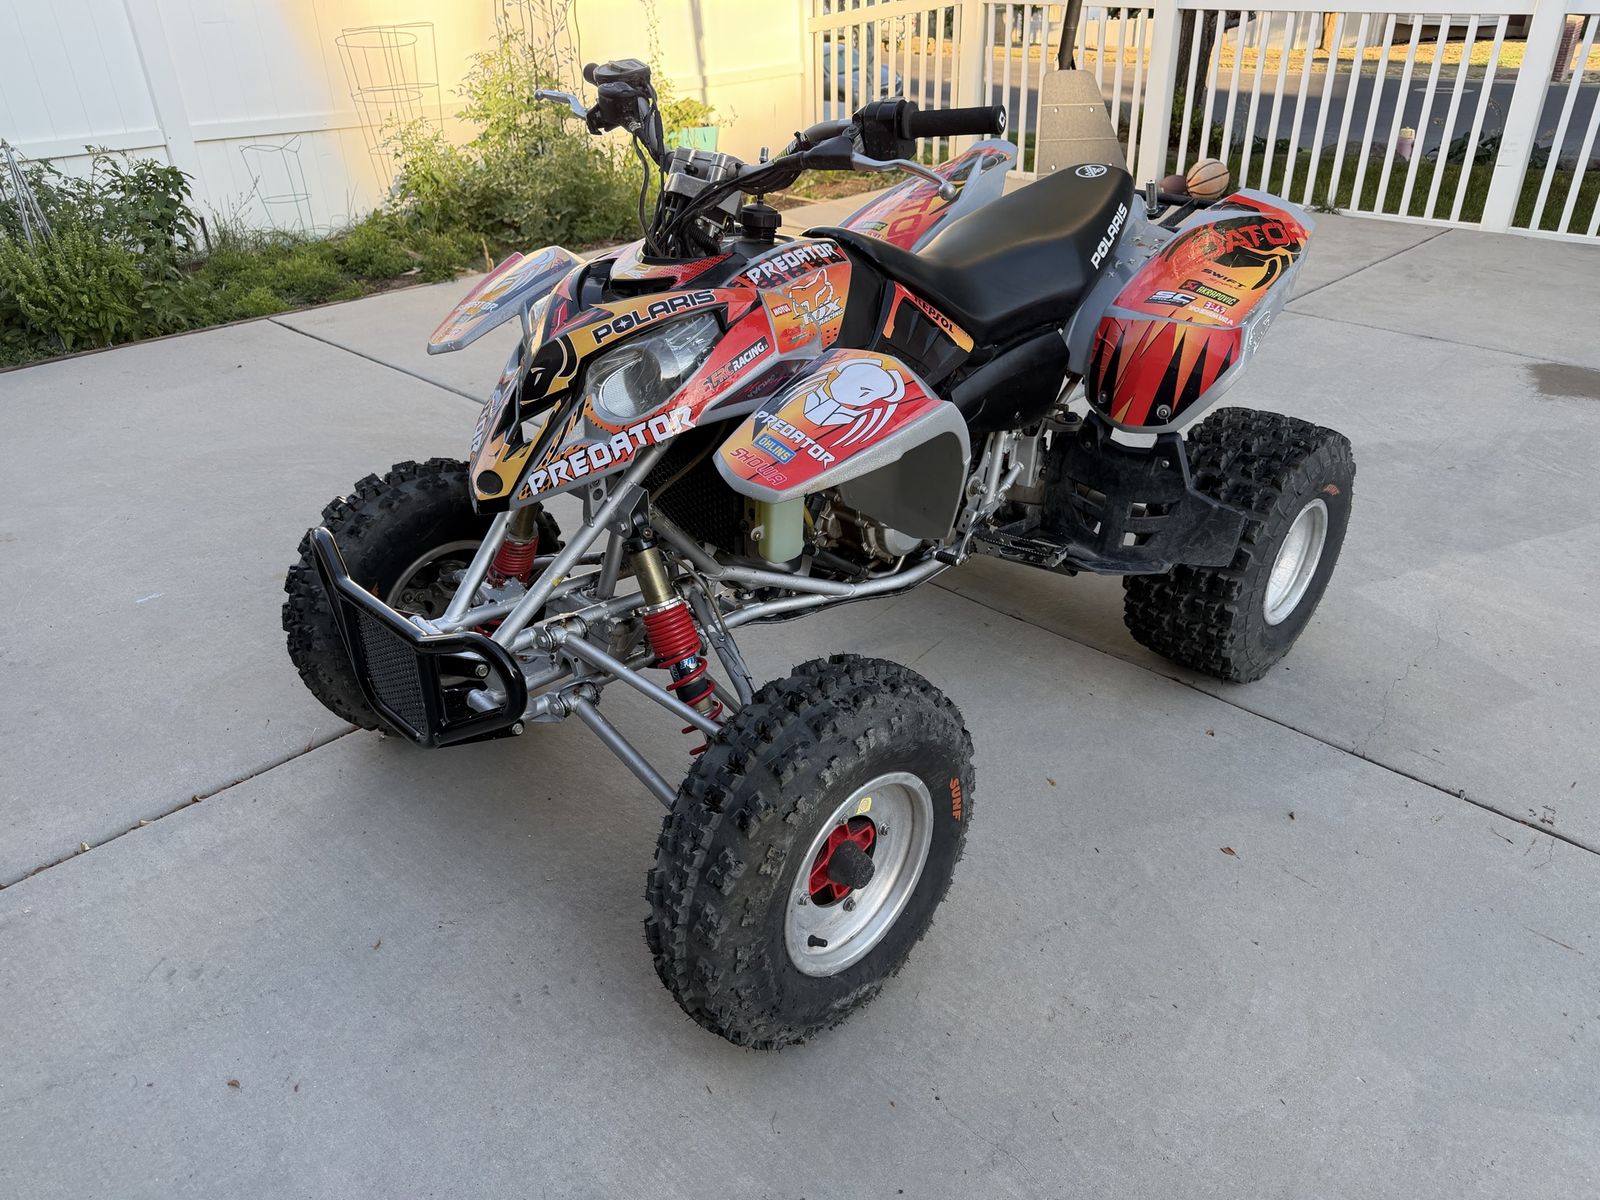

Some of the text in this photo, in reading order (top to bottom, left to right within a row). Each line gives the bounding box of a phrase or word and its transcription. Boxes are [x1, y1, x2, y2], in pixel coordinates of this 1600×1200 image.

[1090, 202, 1128, 270] POLARIS
[746, 242, 836, 287] PREDATOR
[1201, 268, 1247, 288] SWIFT
[591, 290, 717, 346] POLARIS
[526, 405, 696, 497] PREDATOR
[754, 410, 836, 471] PREDATOR
[730, 447, 787, 486] SHOWA
[949, 777, 962, 822] SUNF
